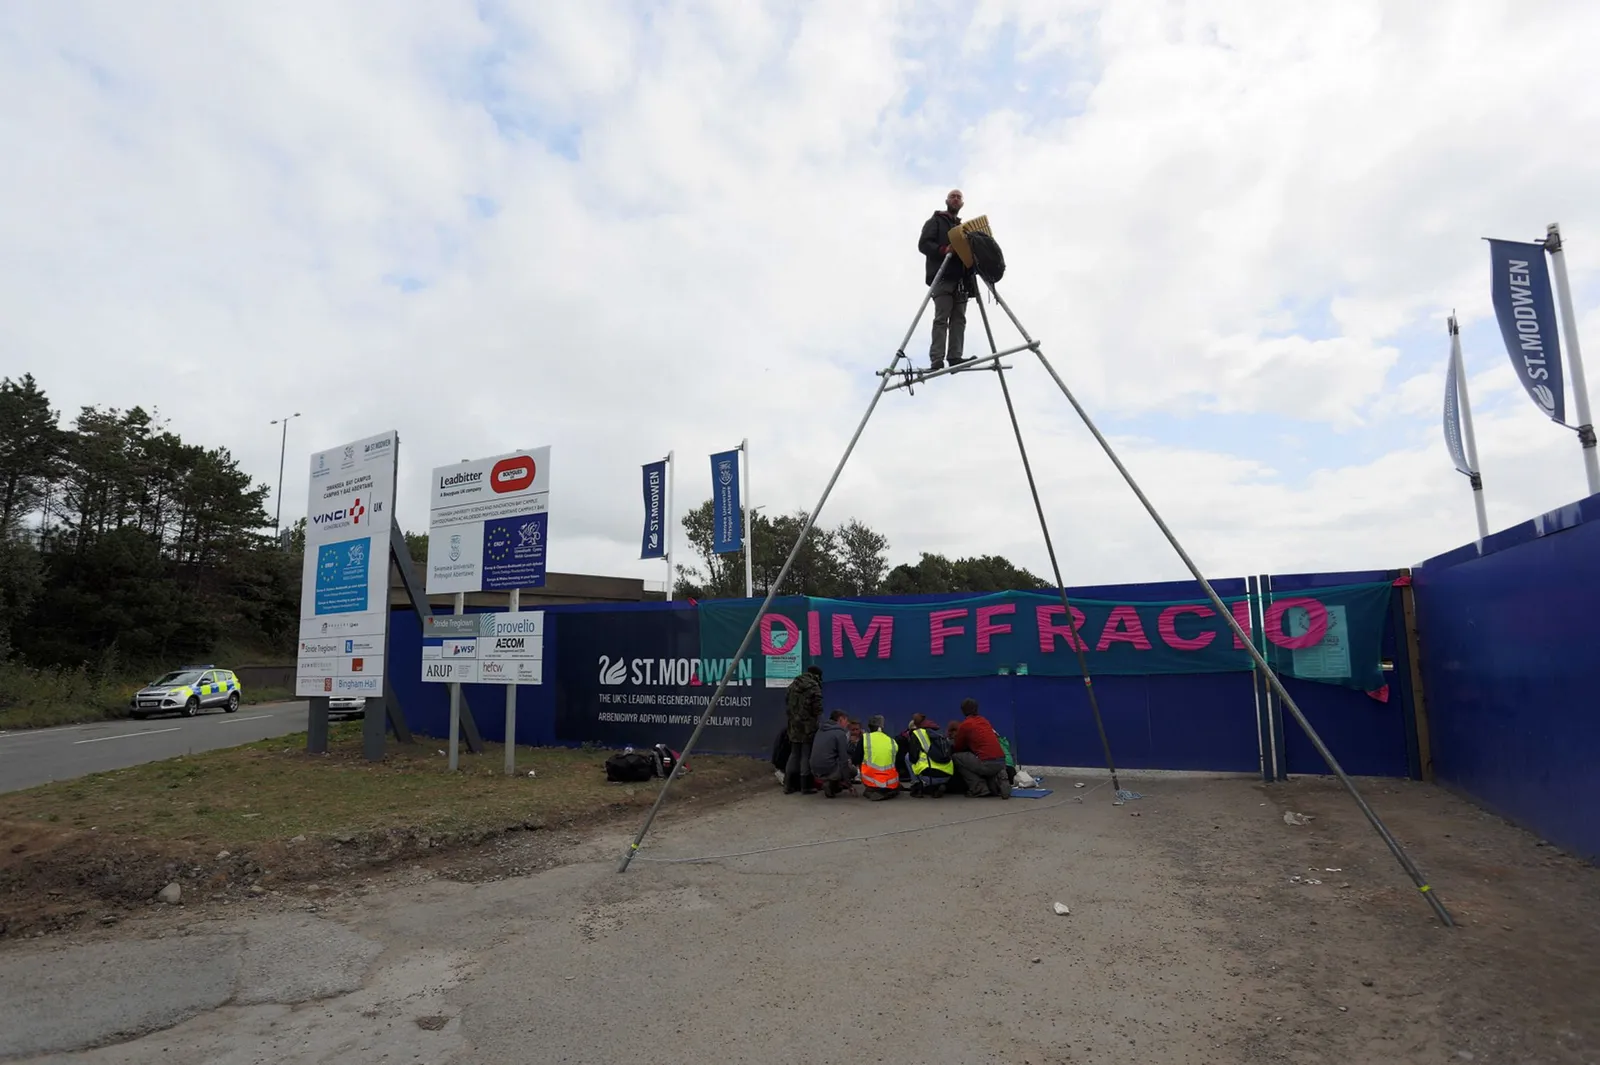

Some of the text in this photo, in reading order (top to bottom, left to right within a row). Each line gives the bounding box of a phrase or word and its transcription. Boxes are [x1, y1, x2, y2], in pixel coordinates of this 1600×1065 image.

[1508, 260, 1549, 381] ST.MODWEN
[440, 471, 482, 489] Leadbitter
[374, 502, 383, 512] UK
[649, 471, 660, 532] ST.MODWEN
[313, 509, 347, 524] VINCI
[433, 619, 474, 630] Stride Treglown
[497, 619, 535, 636] provelio
[760, 611, 894, 659] DIM
[460, 645, 475, 653] WSP
[495, 638, 525, 649] AECOM
[426, 664, 453, 677] ARUP
[338, 679, 377, 689] Bingham Hall
[599, 693, 611, 704] THE
[612, 694, 628, 704] UK'S
[628, 694, 656, 705] LEADING
[657, 695, 709, 706] REGENERATION
[639, 713, 667, 724] ADFYWIO
[668, 714, 692, 725] MWYAF
[741, 716, 752, 727] DU
